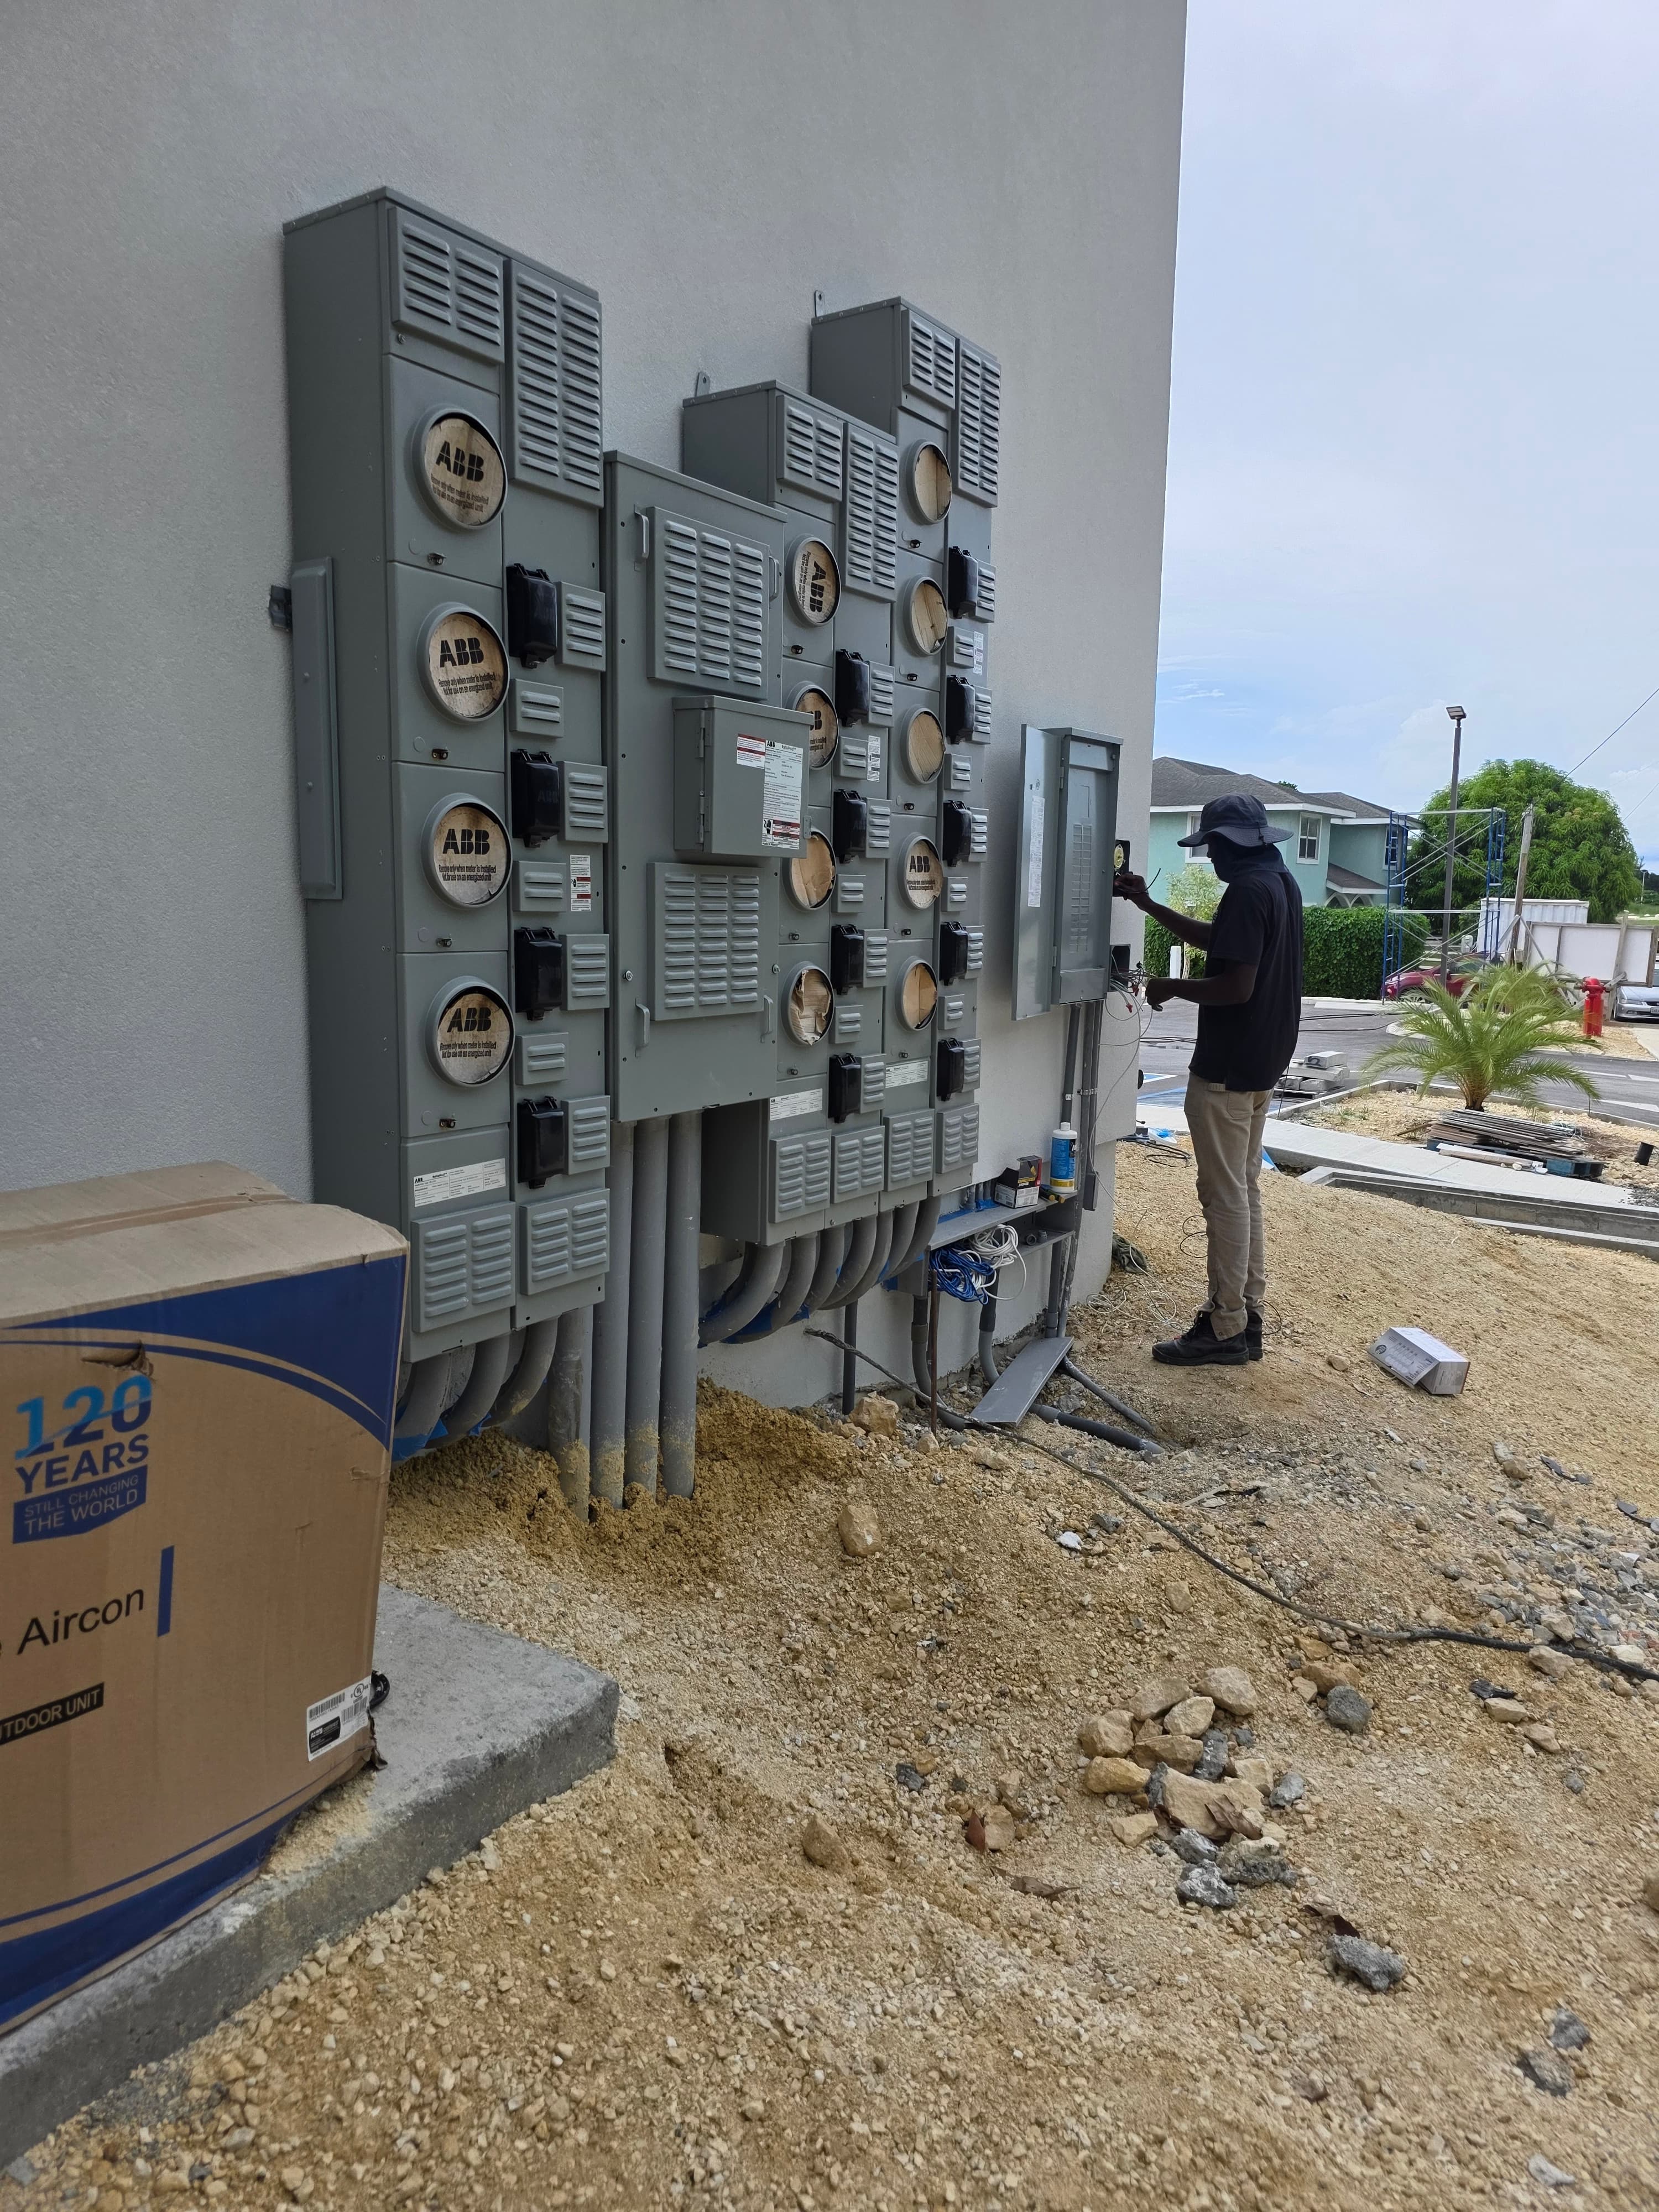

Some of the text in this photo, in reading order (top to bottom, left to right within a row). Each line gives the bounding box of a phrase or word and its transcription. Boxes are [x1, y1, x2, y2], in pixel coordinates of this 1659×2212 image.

[436, 441, 484, 482] ABB
[810, 561, 826, 612] ABB
[440, 638, 484, 667] ABB
[442, 828, 490, 854] ABB
[466, 864, 476, 873] meter
[476, 864, 480, 873] is
[909, 855, 930, 872] ABB
[447, 1008, 492, 1032] ABB
[477, 1041, 481, 1049] is
[15, 1375, 152, 1460] 120
[15, 1434, 149, 1494] YEARS
[24, 1475, 138, 1517] STILL CHANGING
[24, 1489, 138, 1535] THE WORLD
[17, 1589, 144, 1655] Aircon
[66, 1689, 101, 1715] UNIT
